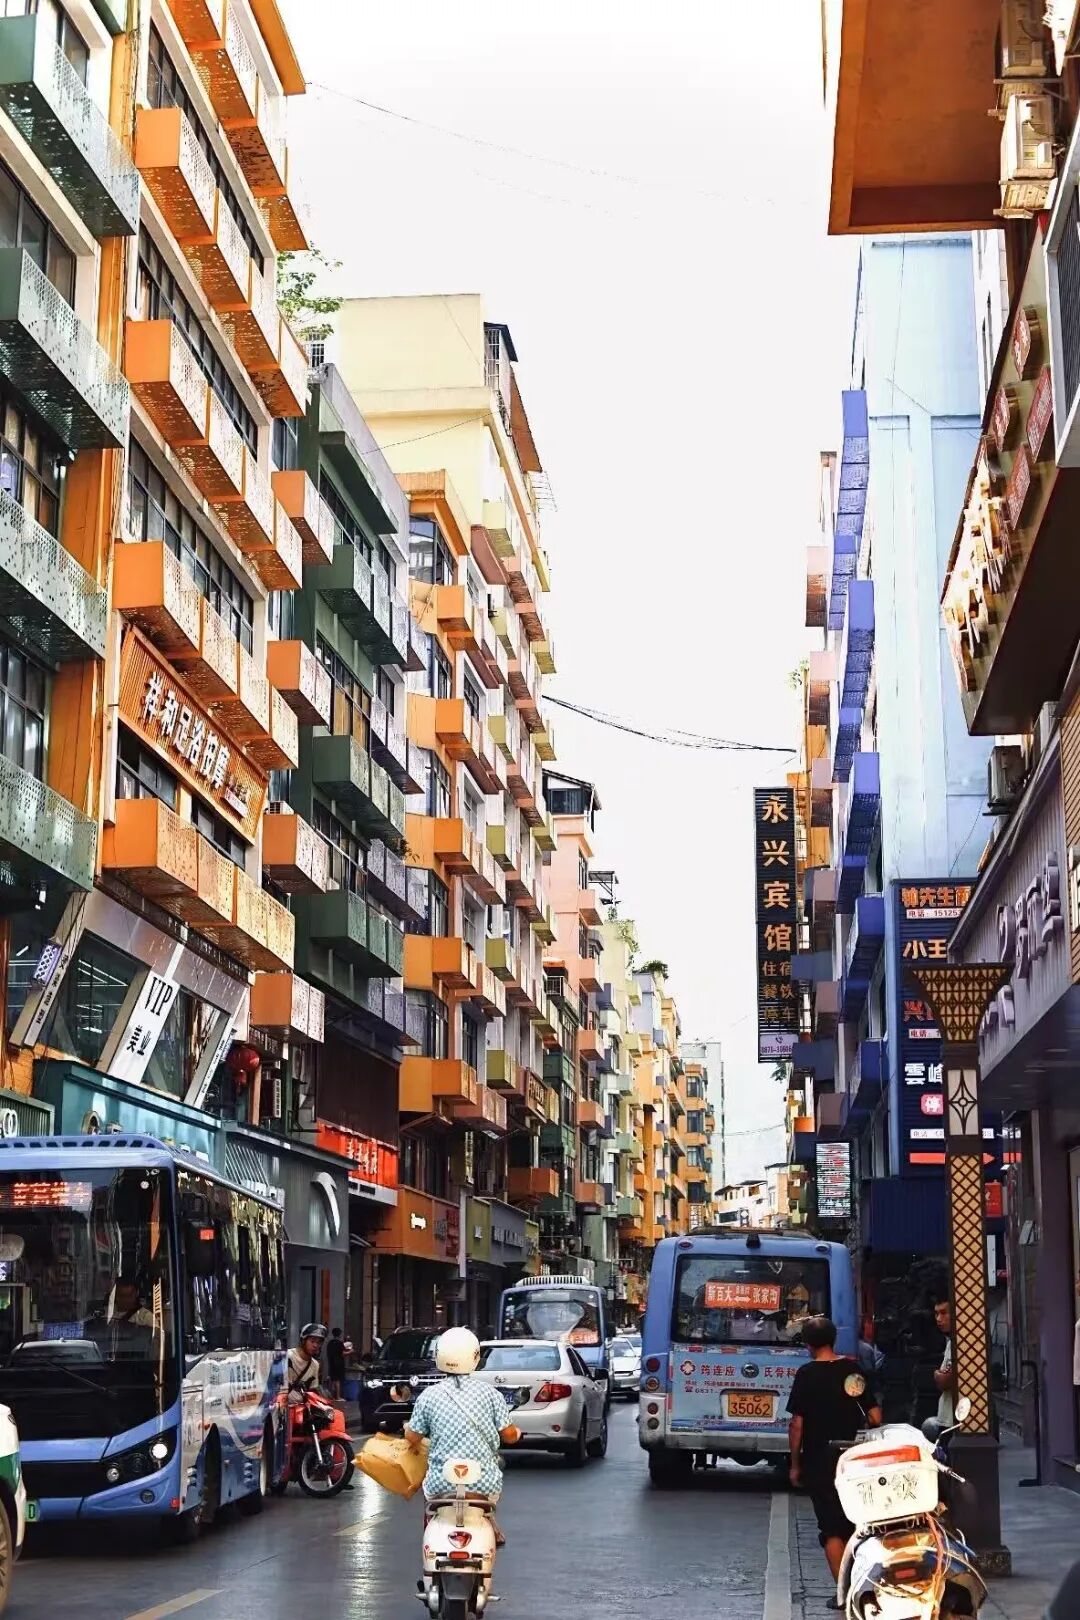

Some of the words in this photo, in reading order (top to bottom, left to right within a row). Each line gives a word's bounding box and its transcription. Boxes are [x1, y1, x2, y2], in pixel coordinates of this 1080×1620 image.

[761, 795, 792, 952] 永兴宾馆
[144, 976, 174, 1017] VIP
[730, 1402, 771, 1416] 35062
